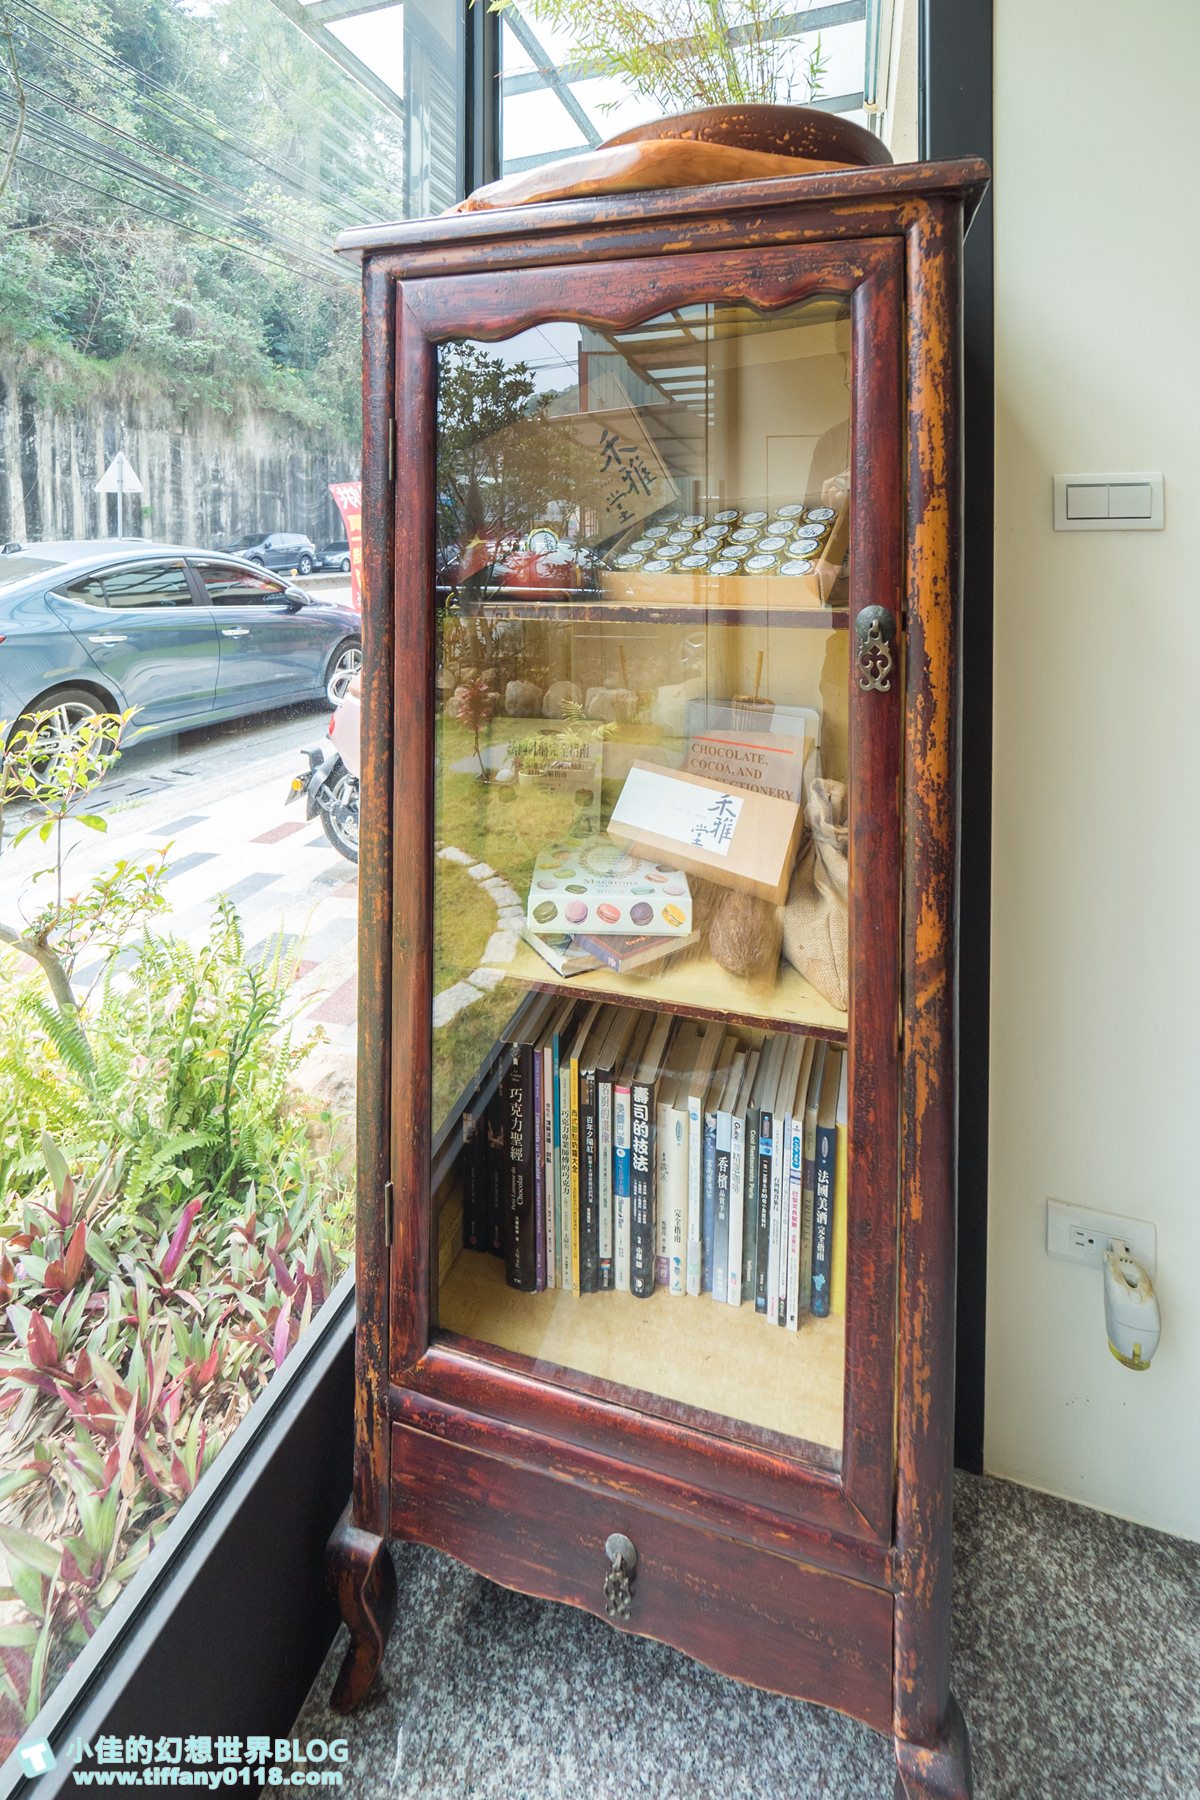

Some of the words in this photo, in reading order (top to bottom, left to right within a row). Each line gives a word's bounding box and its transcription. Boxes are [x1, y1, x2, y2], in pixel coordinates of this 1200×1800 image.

[599, 429, 658, 524] 禾雅堂
[690, 758, 734, 775] COCOA,
[737, 766, 762, 779] AND
[691, 743, 769, 766] CHOCOLATE,
[691, 794, 737, 847] 禾雅堂
[509, 1088, 524, 1162] 巧克力聖經
[632, 1086, 650, 1173] 壽司的技法
[748, 1145, 756, 1182] Restaurants
[516, 1175, 524, 1205] Chocolat
